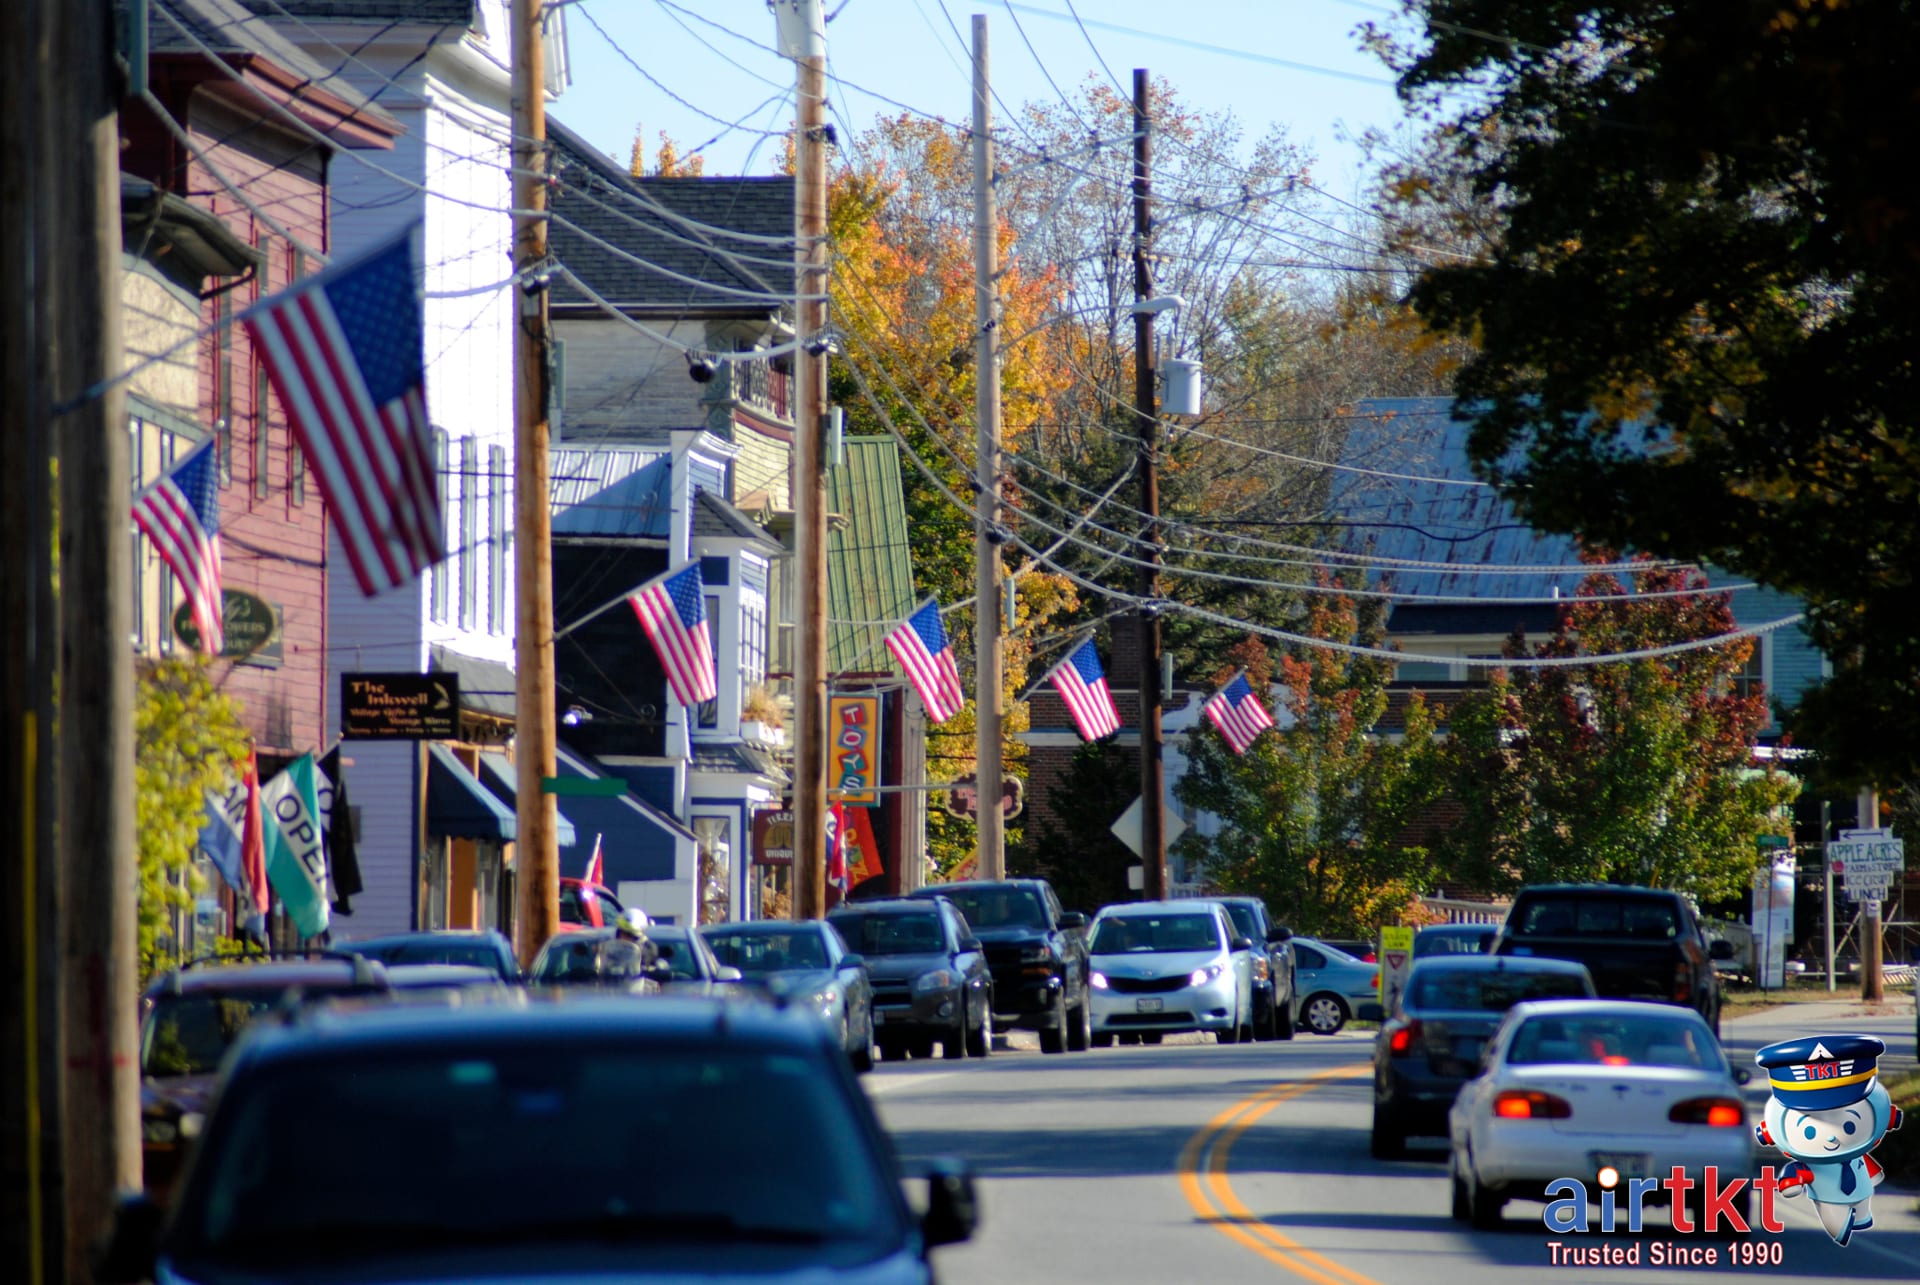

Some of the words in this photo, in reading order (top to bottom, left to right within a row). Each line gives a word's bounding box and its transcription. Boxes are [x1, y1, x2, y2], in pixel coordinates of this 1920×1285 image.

[352, 681, 385, 693] The
[367, 693, 428, 705] Inkwell
[842, 706, 863, 791] TOYS
[766, 849, 793, 859] UNIQU
[1831, 844, 1864, 862] APPLE
[1867, 843, 1902, 861] ACRES
[1849, 887, 1886, 900] LUNCH
